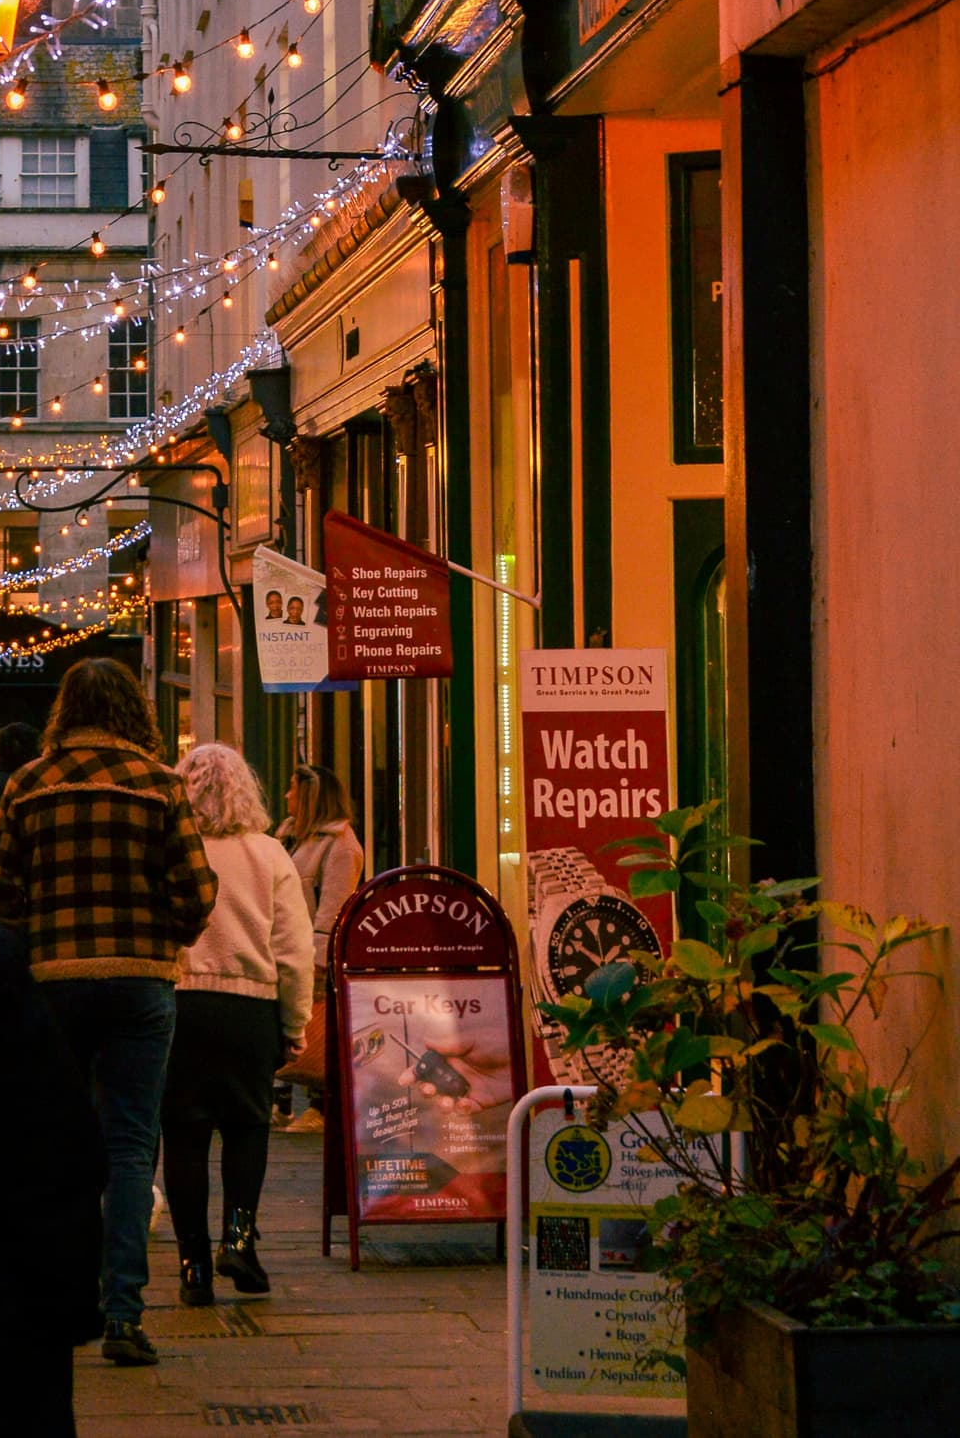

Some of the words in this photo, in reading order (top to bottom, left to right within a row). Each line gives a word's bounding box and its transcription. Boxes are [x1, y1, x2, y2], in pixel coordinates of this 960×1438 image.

[352, 567, 381, 579] Shoe
[384, 566, 428, 581] Repairs
[352, 586, 374, 601] Key
[377, 585, 419, 600] Cutting
[352, 606, 391, 618] Watch
[394, 605, 438, 619] Repairs
[258, 631, 311, 642] INSTANT
[354, 624, 413, 640] Engraving
[354, 644, 393, 657] Phone
[396, 643, 442, 658] Repairs
[366, 664, 416, 674] TIMPSON
[531, 665, 654, 686] TIMPSON
[590, 689, 599, 697] by
[625, 688, 650, 696] People
[540, 729, 648, 770] Watch
[533, 778, 662, 829] Repairs
[358, 893, 490, 937] TIMPSON
[422, 945, 431, 953] by
[457, 944, 484, 952] People
[374, 994, 416, 1015] Car
[424, 994, 482, 1018] Keys
[369, 1107, 380, 1117] Up
[381, 1103, 391, 1113] to
[366, 1118, 383, 1130] less
[385, 1112, 403, 1124] than
[404, 1107, 418, 1117] car
[372, 1118, 419, 1139] dealerships
[448, 1122, 481, 1132] Repairs
[449, 1145, 489, 1154] Batteries
[366, 1159, 427, 1171] LIFETIME
[367, 1172, 428, 1182] GUARANTEE
[413, 1197, 469, 1207] TIMPSON
[556, 1287, 626, 1302] Handmade
[605, 1309, 657, 1324] Crystals
[616, 1329, 646, 1344] Bags
[590, 1348, 632, 1362] Henna
[545, 1367, 586, 1380] Indian
[601, 1369, 658, 1384] Nepalese
